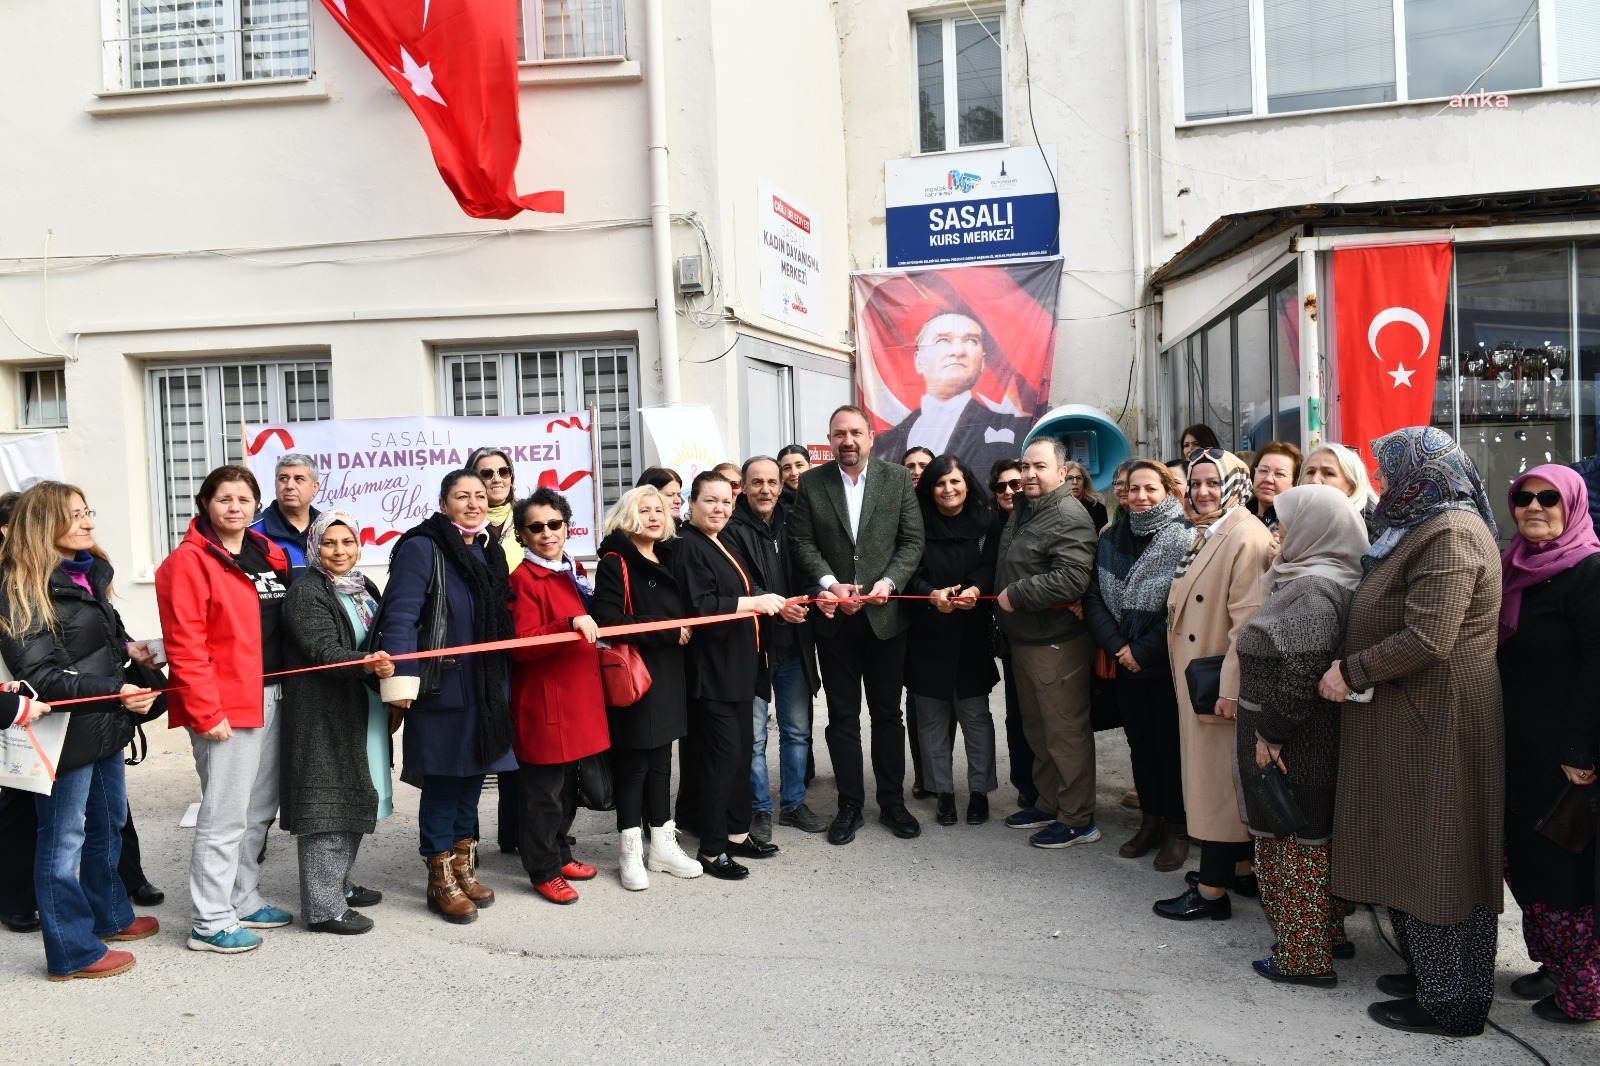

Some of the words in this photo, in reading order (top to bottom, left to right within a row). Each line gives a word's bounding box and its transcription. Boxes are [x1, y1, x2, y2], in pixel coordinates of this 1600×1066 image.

[929, 202, 1013, 232] SASALI
[929, 233, 960, 247] KURS
[963, 226, 1015, 244] MERKEZİ
[763, 230, 785, 254] KADIN
[786, 242, 819, 273] DAYANIŞMA
[780, 260, 808, 285] MERKEZİ
[371, 430, 451, 448] SASALI
[338, 448, 462, 470] DAYANIŞMA
[312, 471, 410, 506] Açılışımıza
[381, 484, 434, 528] Hoş
